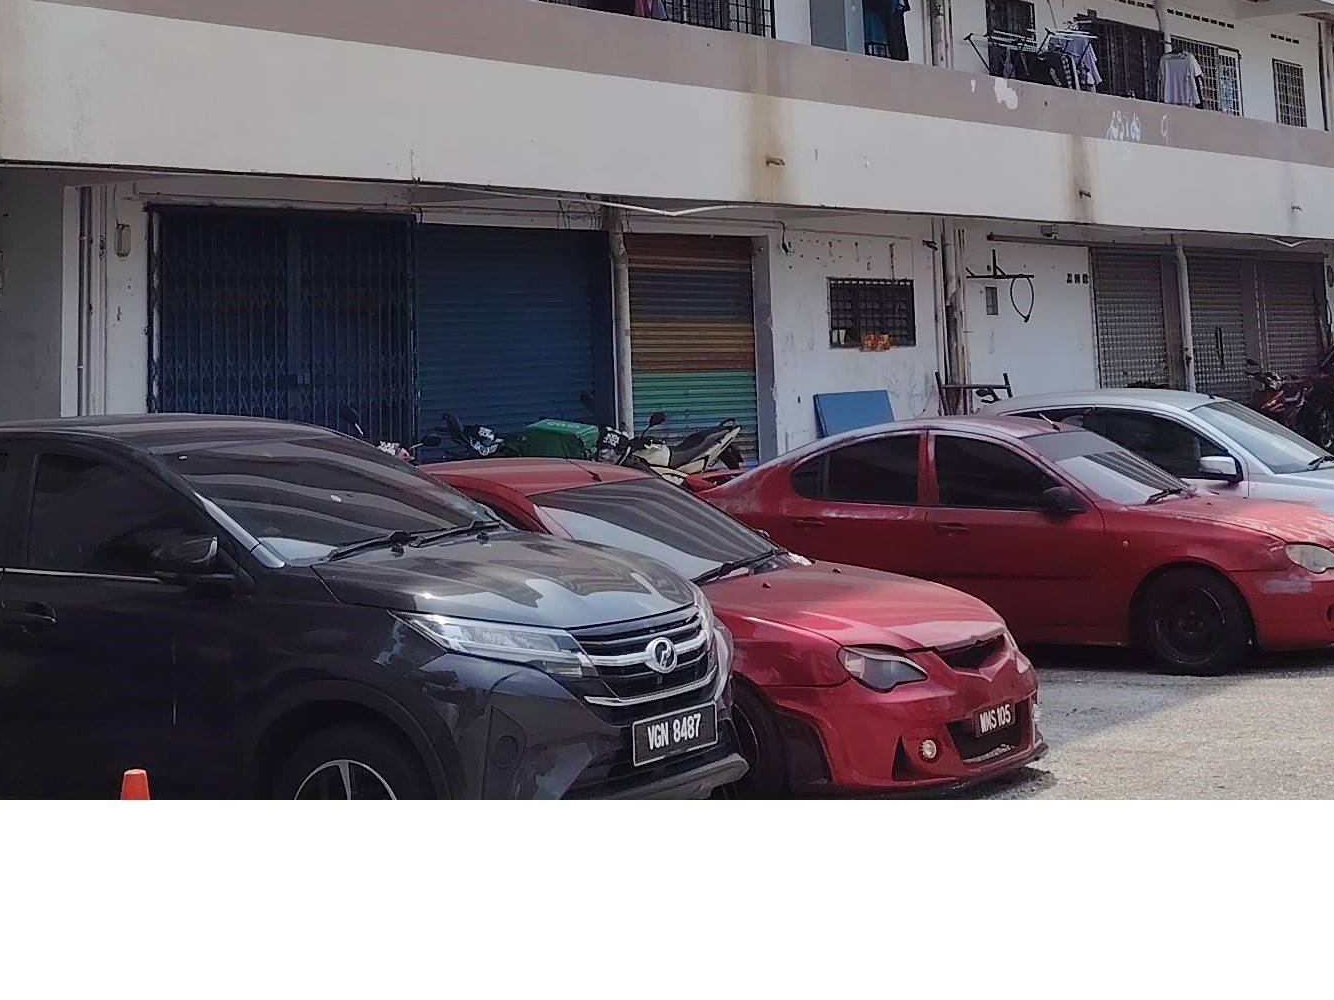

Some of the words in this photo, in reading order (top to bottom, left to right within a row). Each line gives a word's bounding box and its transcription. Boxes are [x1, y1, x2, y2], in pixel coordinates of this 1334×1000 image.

[997, 704, 1011, 726] 105
[648, 722, 669, 750] VGN
[673, 713, 701, 742] 8487
